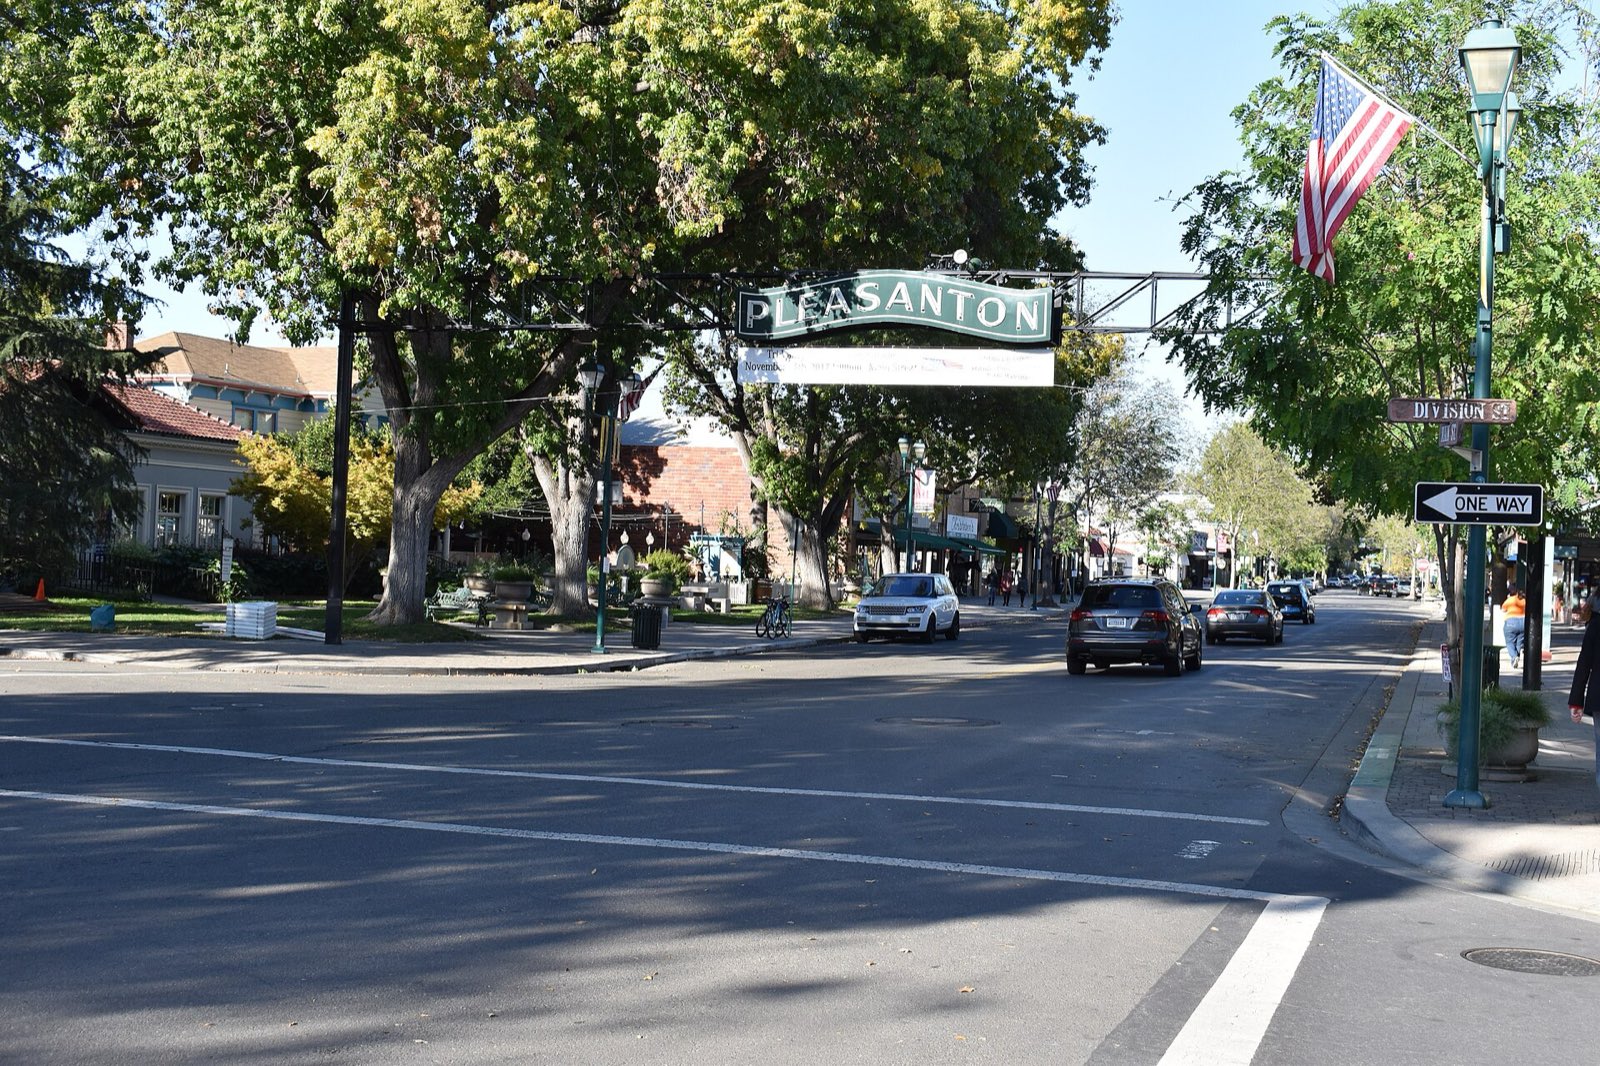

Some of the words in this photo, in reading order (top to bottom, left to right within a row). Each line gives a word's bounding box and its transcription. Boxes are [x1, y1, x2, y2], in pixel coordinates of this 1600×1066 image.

[747, 281, 1039, 332] PLEASANTON
[1413, 401, 1486, 420] DIVISION
[1455, 496, 1488, 512] ONE
[1496, 497, 1529, 512] WAY
